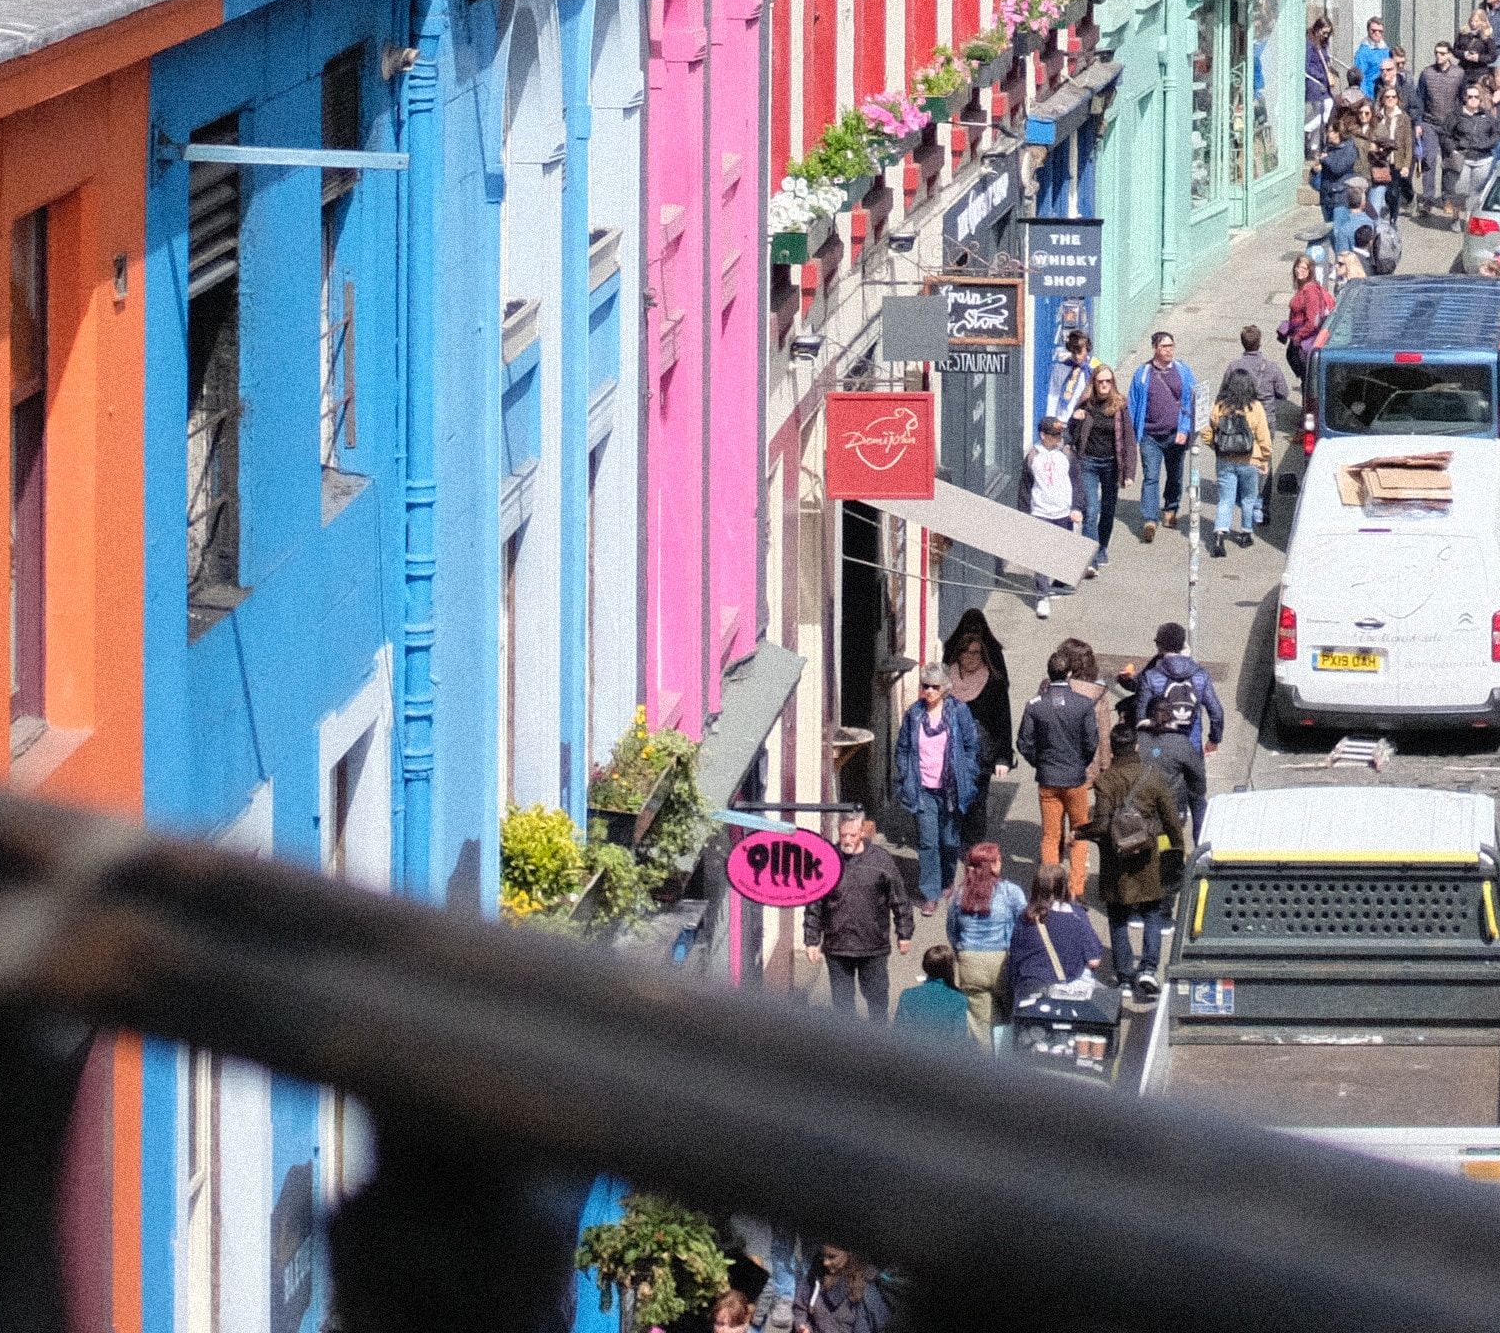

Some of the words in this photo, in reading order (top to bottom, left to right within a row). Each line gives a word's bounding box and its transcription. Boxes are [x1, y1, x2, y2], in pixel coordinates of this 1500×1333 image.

[1049, 234, 1082, 246] THE
[1033, 255, 1098, 267] WHISKY
[1043, 275, 1087, 287] SHOP
[958, 309, 1008, 334] Store
[1321, 654, 1349, 667] PX19
